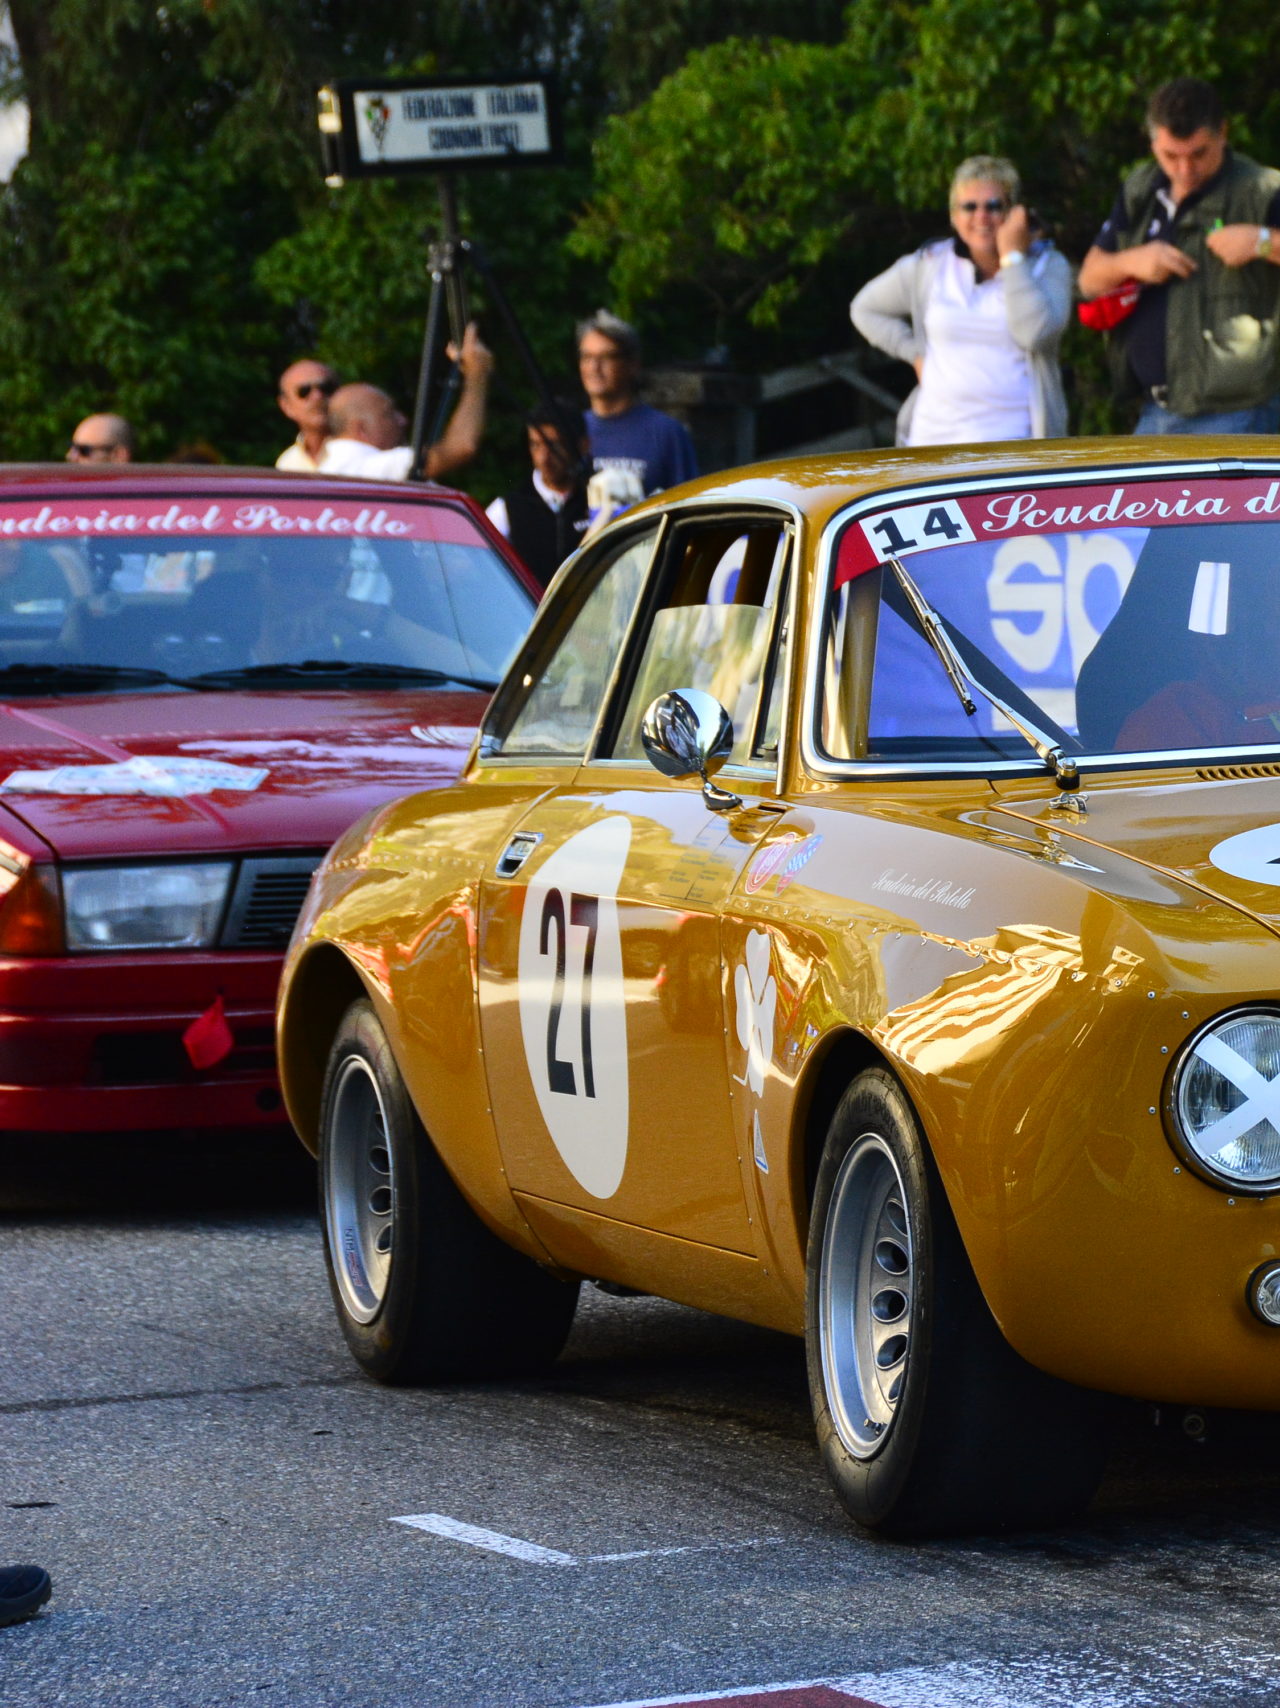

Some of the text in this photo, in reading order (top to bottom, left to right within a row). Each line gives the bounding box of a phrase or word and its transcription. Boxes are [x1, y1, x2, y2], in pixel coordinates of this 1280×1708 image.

[146, 505, 224, 531] del
[232, 505, 417, 535] Portello
[872, 506, 963, 556] 14
[981, 487, 1231, 532] Scuderia
[539, 886, 600, 1099] 27
